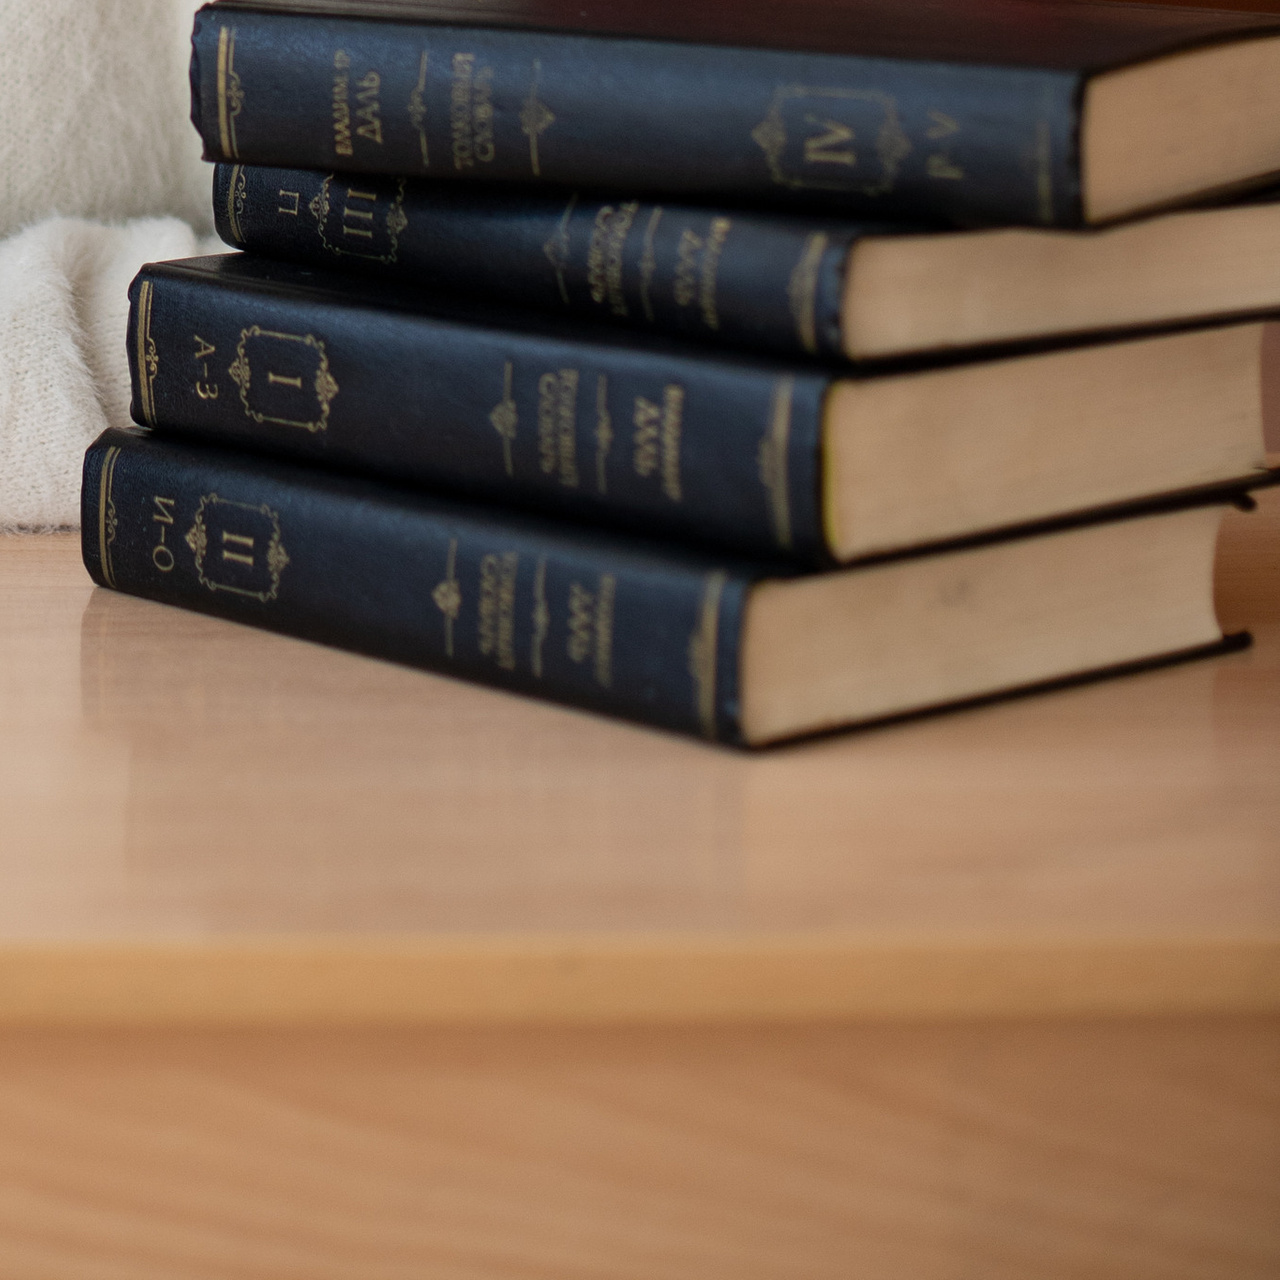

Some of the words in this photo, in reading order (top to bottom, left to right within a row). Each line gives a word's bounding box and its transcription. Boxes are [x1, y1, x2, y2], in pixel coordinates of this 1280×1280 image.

[355, 70, 383, 144] ДАЛЬ
[802, 111, 857, 166] IV
[277, 188, 301, 216] П
[342, 187, 377, 240] III
[267, 371, 302, 390] I
[222, 530, 255, 568] II
